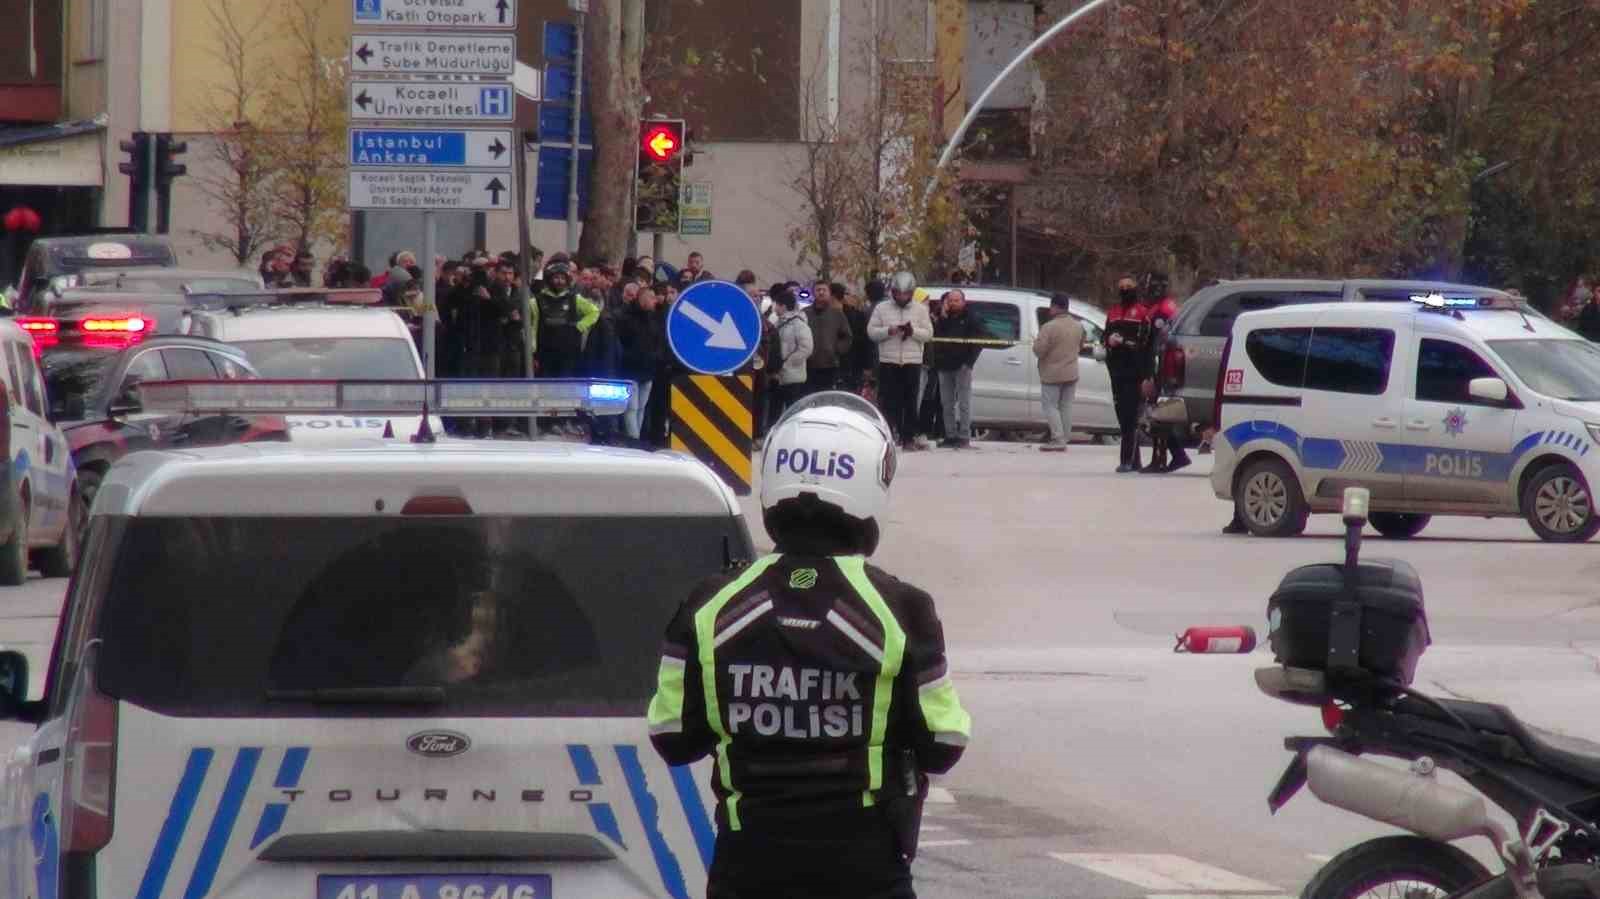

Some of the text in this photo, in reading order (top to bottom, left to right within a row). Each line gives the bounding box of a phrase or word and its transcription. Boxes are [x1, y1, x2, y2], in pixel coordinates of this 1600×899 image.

[426, 10, 487, 24] Otopark
[379, 41, 511, 54] Trafik Denetleme
[396, 87, 459, 100] Kocaeli
[358, 150, 428, 163] Ankara
